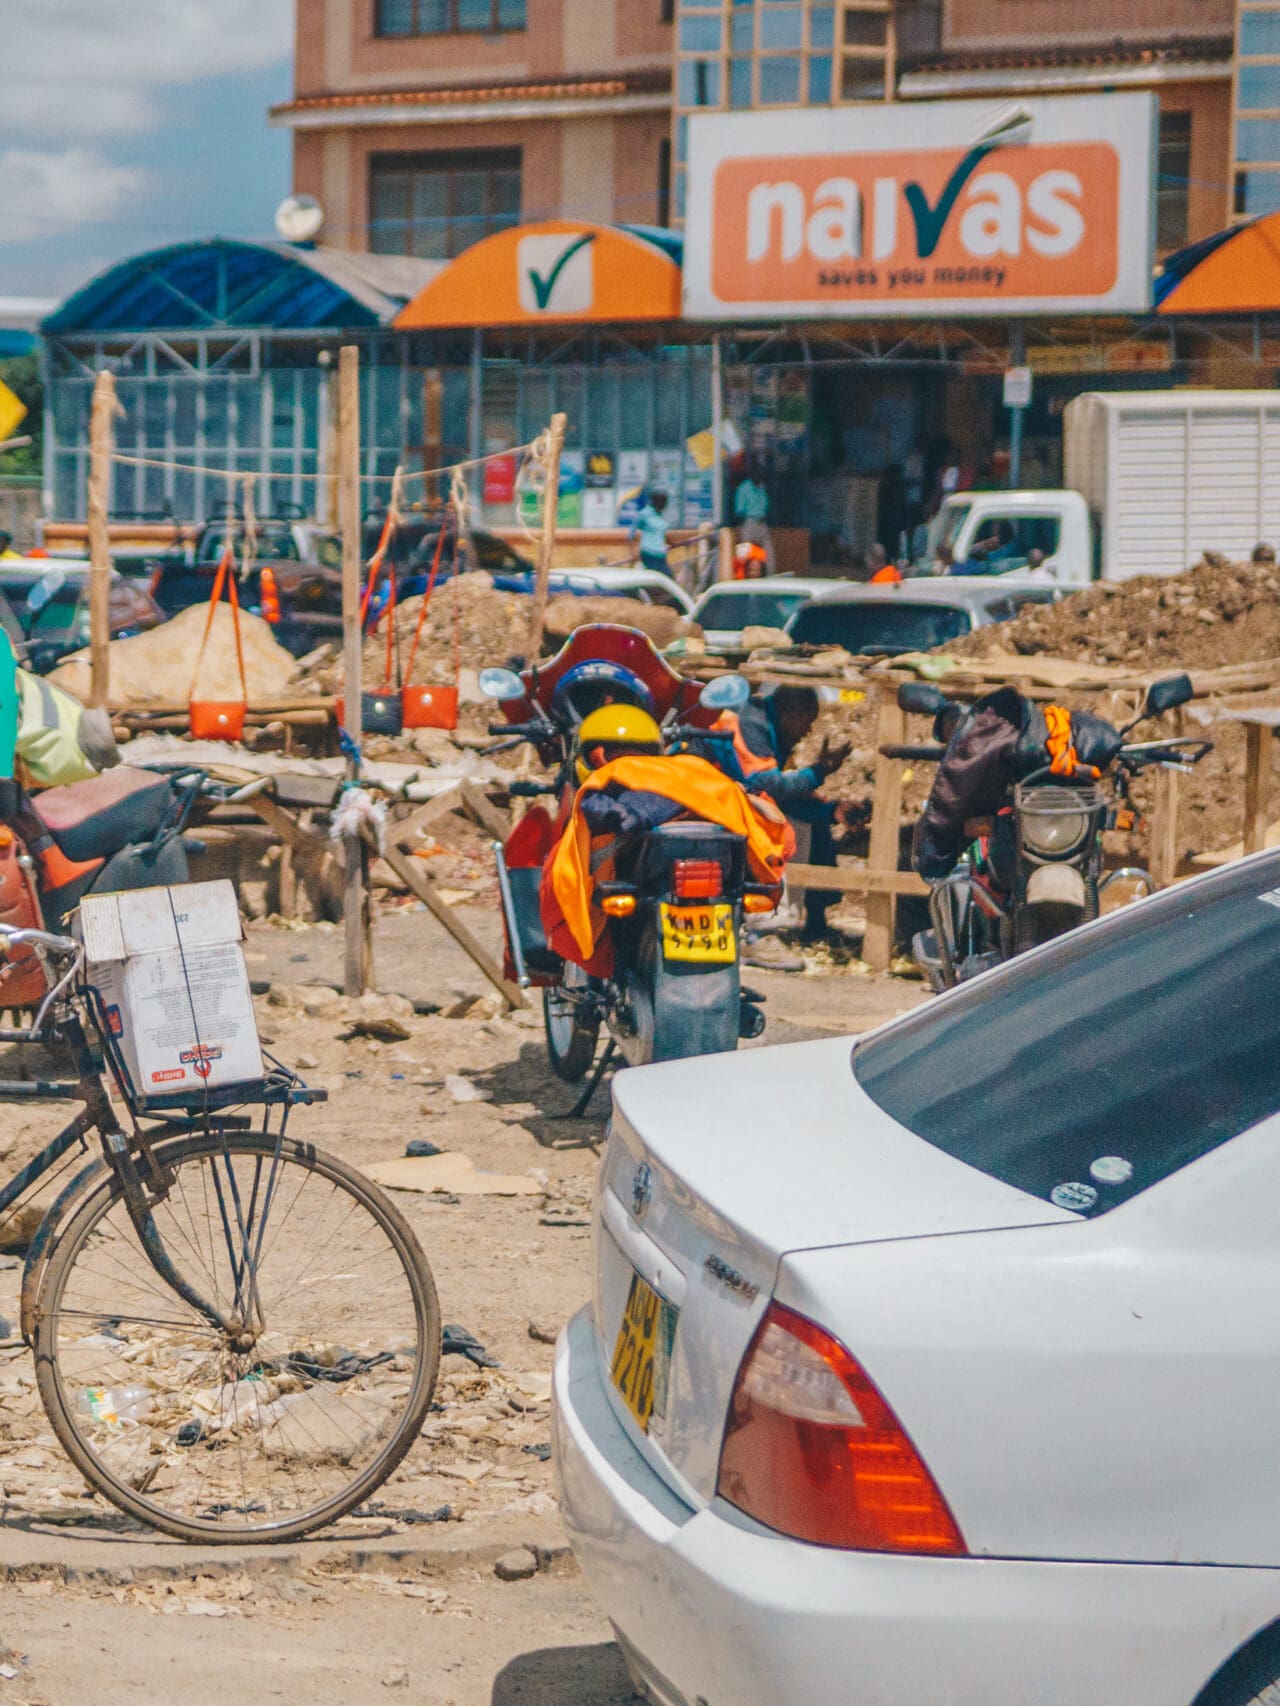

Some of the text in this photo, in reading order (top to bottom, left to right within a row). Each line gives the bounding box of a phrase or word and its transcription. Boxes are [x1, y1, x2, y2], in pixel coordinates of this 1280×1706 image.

[746, 143, 1087, 264] naivas
[817, 265, 1006, 288] saves you money
